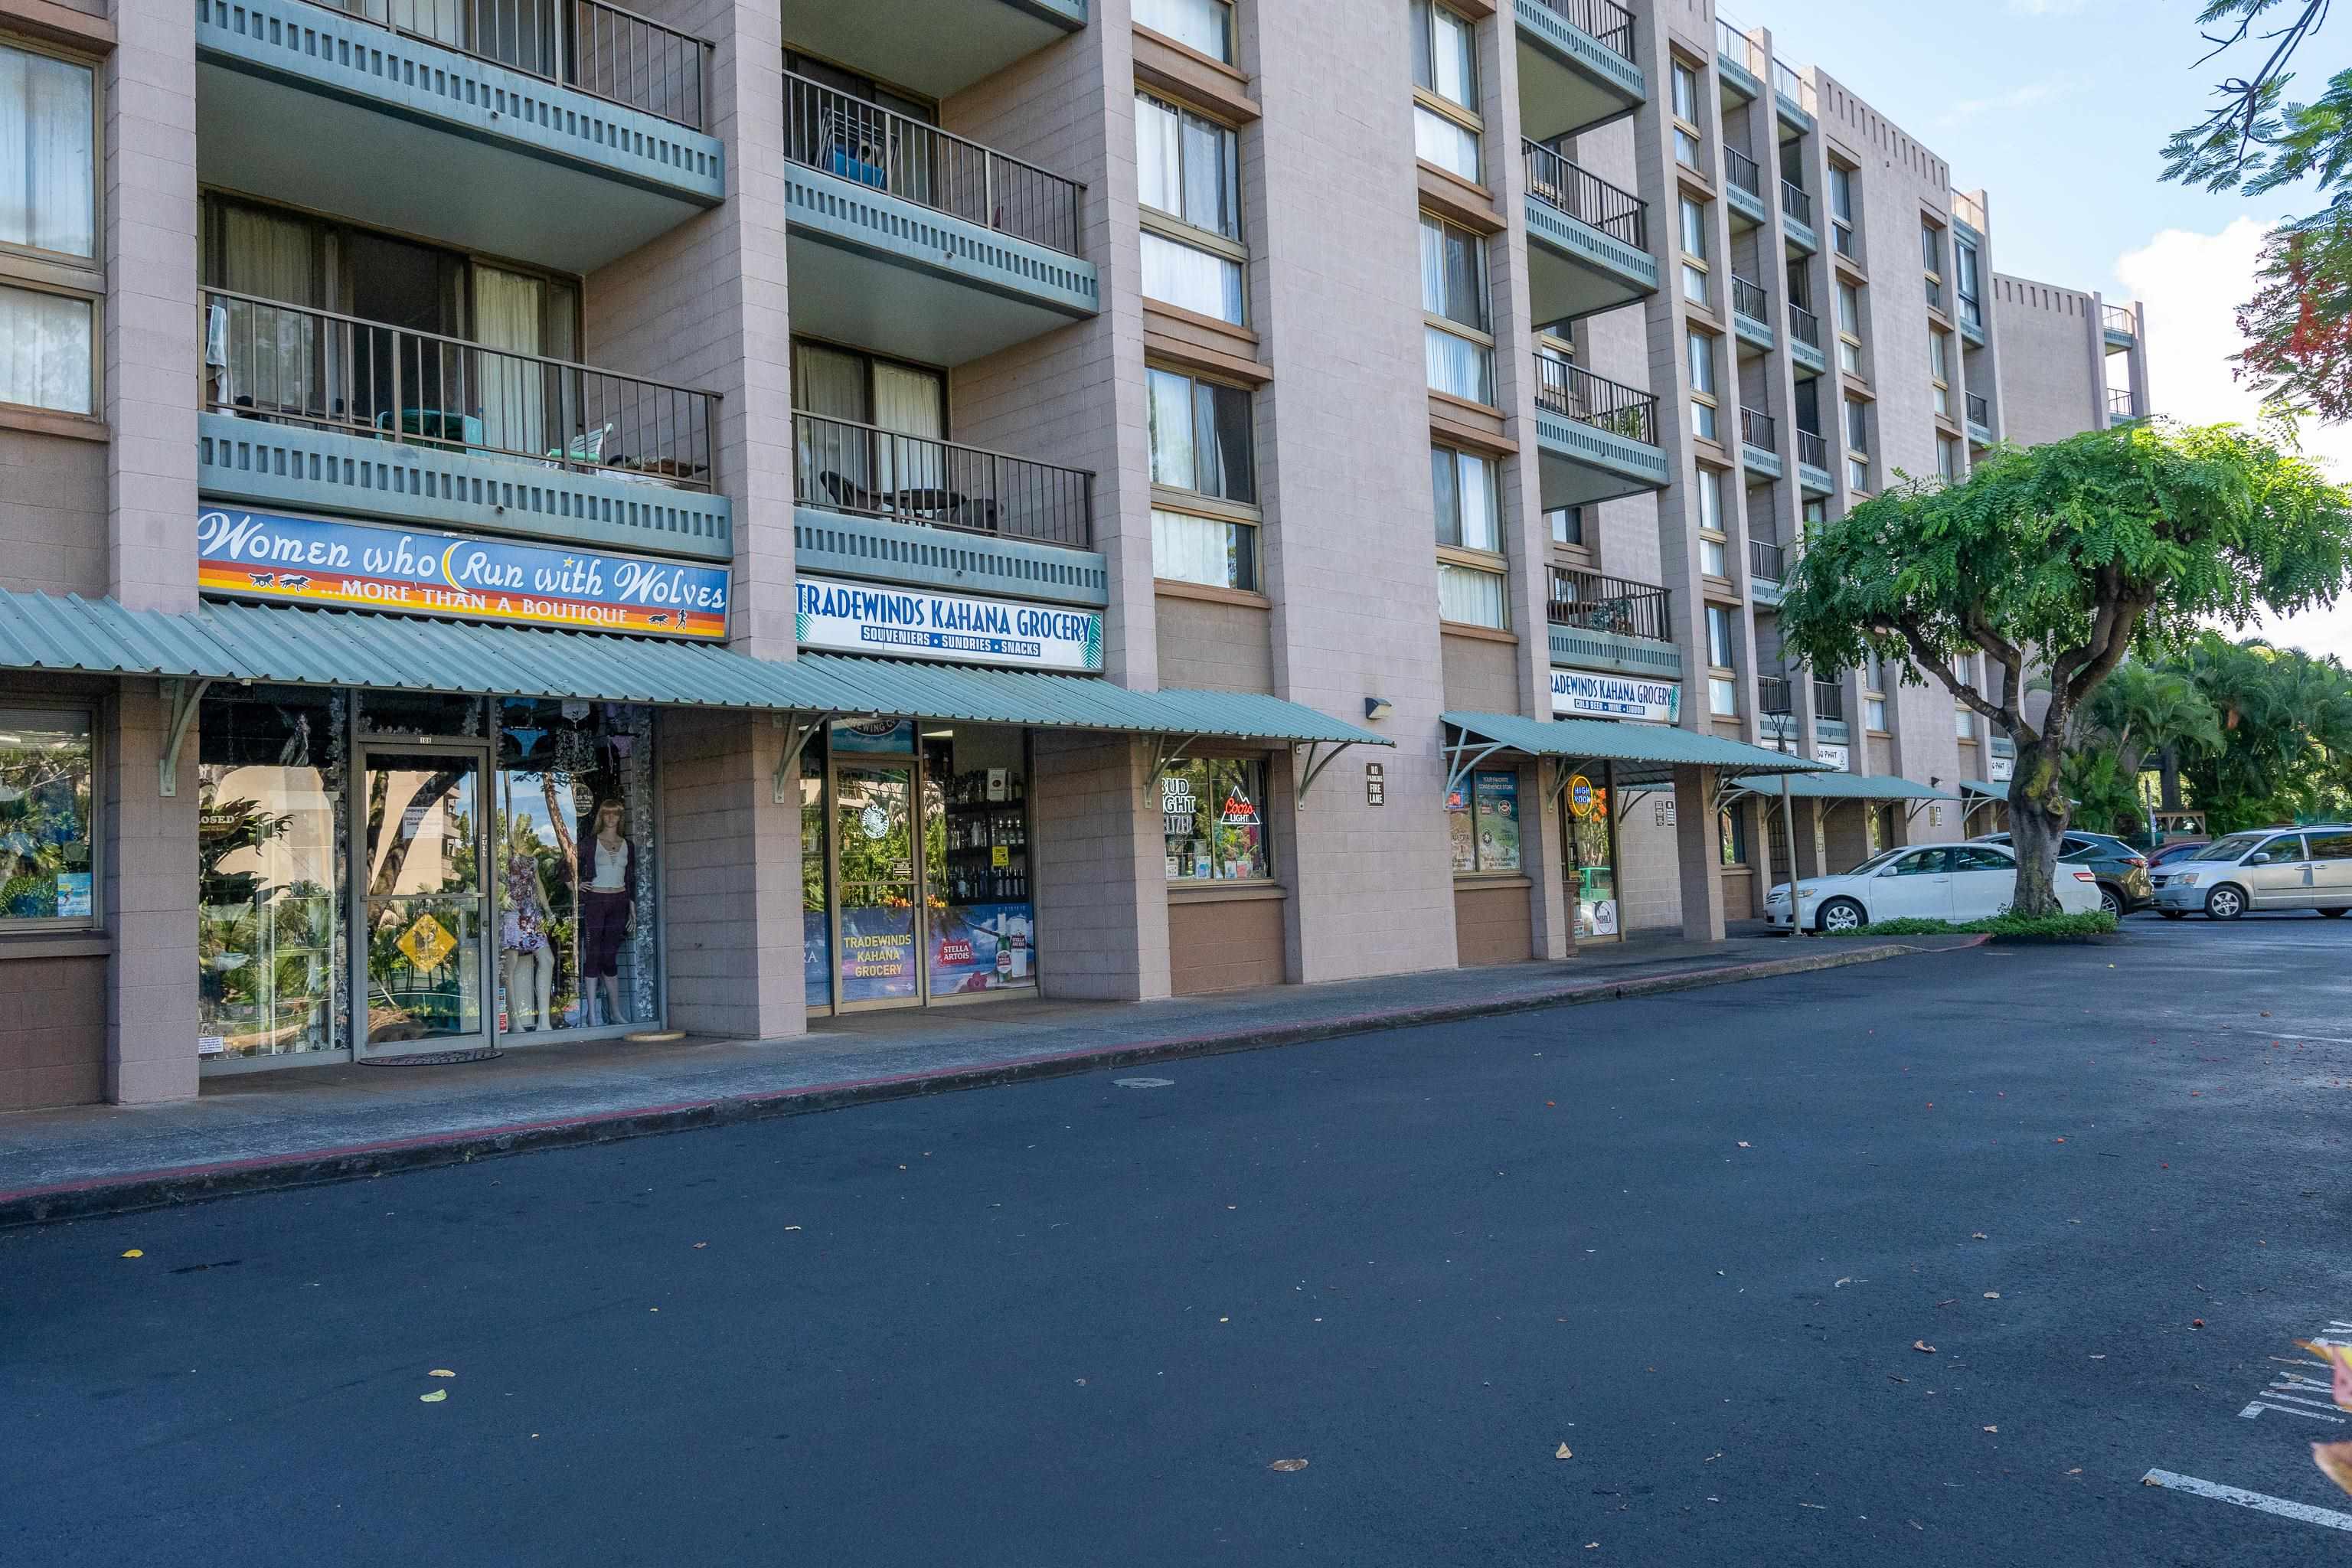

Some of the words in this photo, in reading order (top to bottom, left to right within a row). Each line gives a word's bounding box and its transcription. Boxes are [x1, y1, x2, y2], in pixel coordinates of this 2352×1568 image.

[198, 512, 351, 567] Women
[363, 536, 436, 577] who
[460, 551, 524, 589] Run
[535, 558, 603, 596] with
[614, 562, 725, 609] Wolves
[422, 588, 486, 610] THAN
[497, 597, 512, 612] A
[523, 598, 627, 625] BOUTIQUE
[795, 583, 925, 627] TRADEWINDS
[931, 599, 1011, 635] KAHANA
[1017, 609, 1090, 642] GROCERY
[863, 626, 930, 645] SOUVENIERS
[942, 635, 991, 652] SUNDRIES
[1001, 644, 1039, 656] SNACKS
[1550, 674, 1597, 698] RADEWINDS
[1600, 679, 1635, 702] KAHANA
[1638, 684, 1671, 706] GROCERY
[1371, 766, 1378, 774] NO
[1370, 784, 1381, 793] FIRE
[1369, 794, 1383, 803] LANE
[1225, 797, 1254, 815] Coors
[200, 815, 235, 824] OSED
[1230, 814, 1249, 822] LIGHT
[1164, 815, 1193, 835] ELTZER
[844, 935, 911, 949] TRADEWINDS
[858, 949, 900, 962] KAHANA
[943, 945, 969, 954] STELLA
[943, 952, 969, 961] ARTOIS
[855, 965, 902, 977] GROCERY
